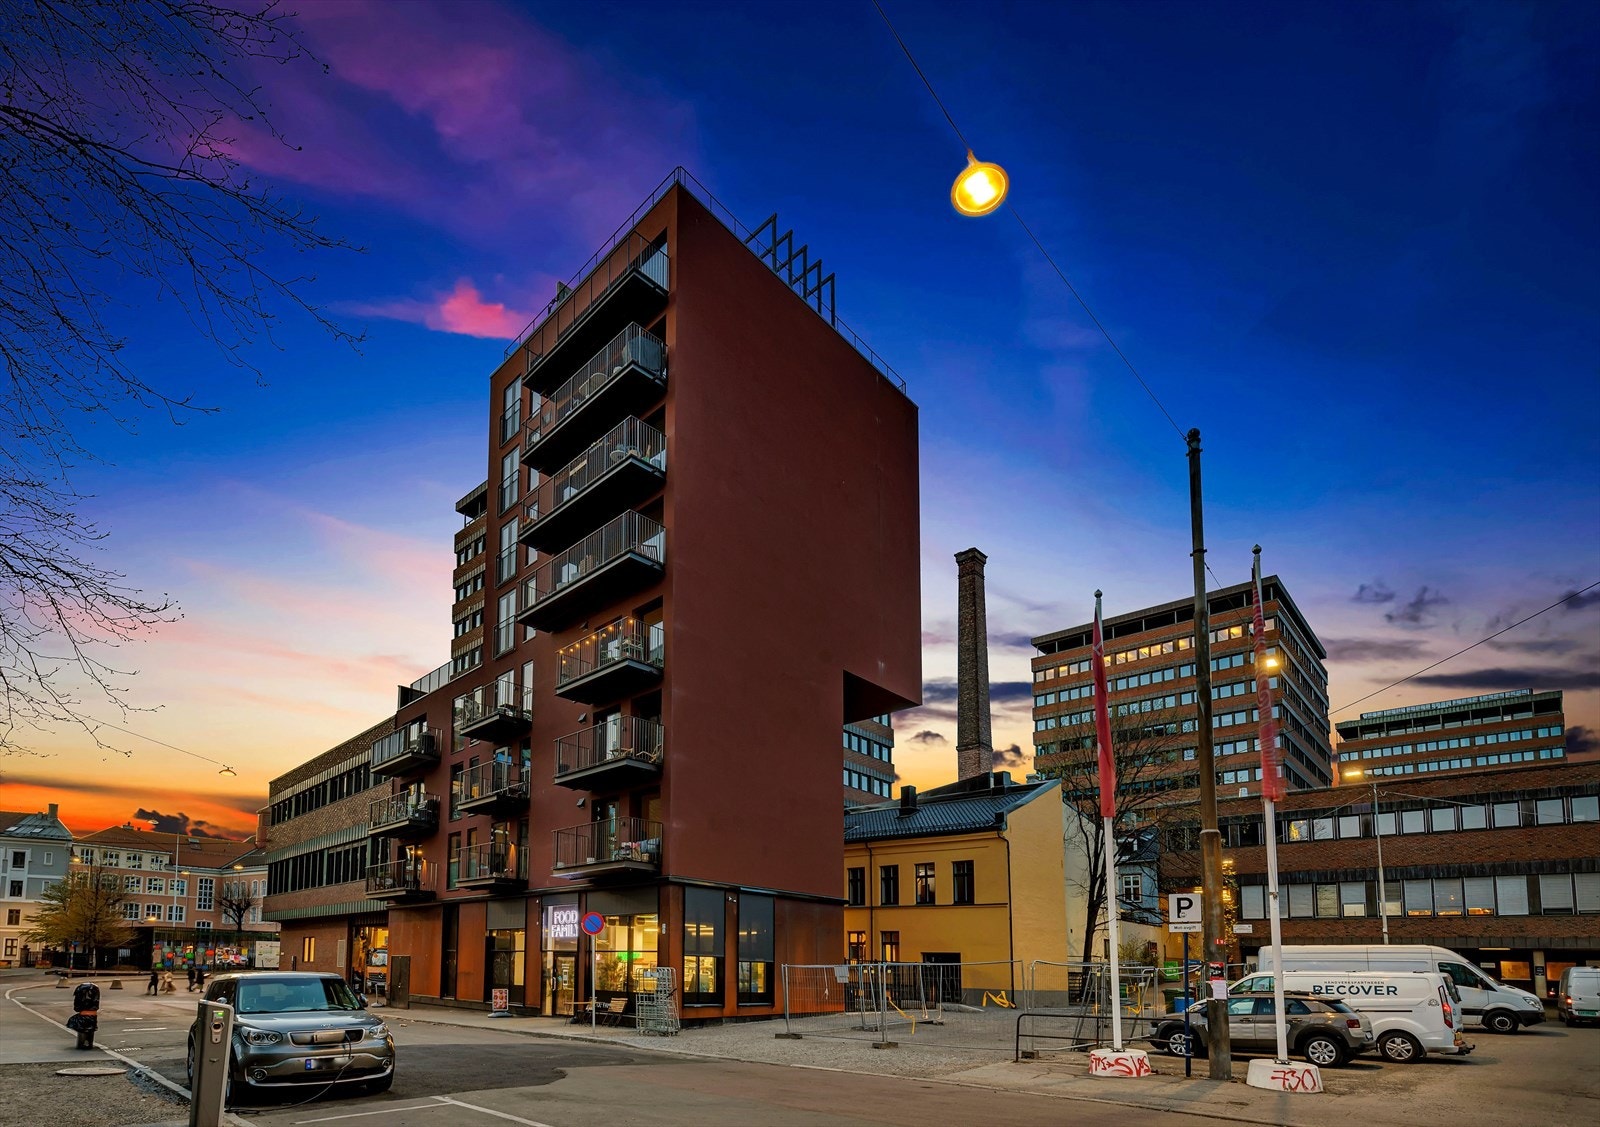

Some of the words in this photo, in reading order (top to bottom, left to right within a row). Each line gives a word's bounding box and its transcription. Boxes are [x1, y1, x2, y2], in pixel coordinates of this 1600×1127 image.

[1176, 897, 1193, 918] P
[553, 910, 578, 924] FOOD
[551, 923, 578, 937] FAMILY
[1312, 984, 1398, 996] RECOVER
